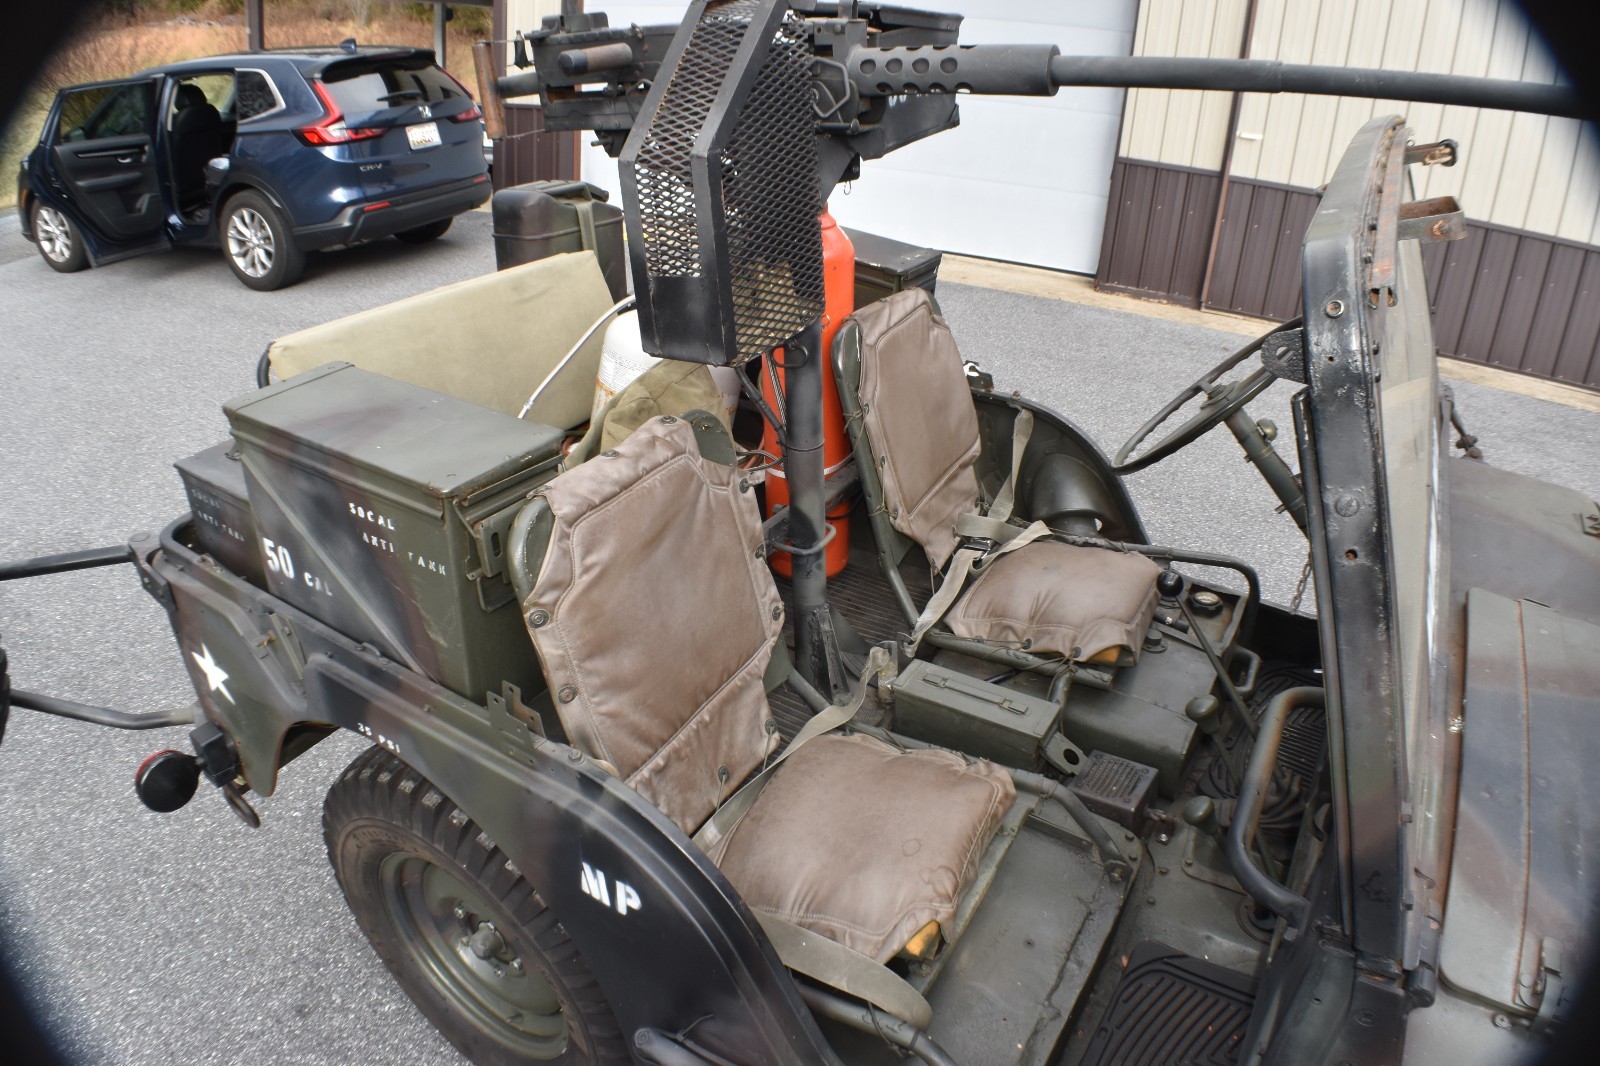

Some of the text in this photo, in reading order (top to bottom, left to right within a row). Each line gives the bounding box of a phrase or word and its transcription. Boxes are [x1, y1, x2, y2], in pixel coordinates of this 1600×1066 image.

[360, 163, 383, 172] CR-V
[362, 532, 395, 553] ANTI
[262, 537, 333, 597] 50 CAL
[581, 861, 642, 916] MP
